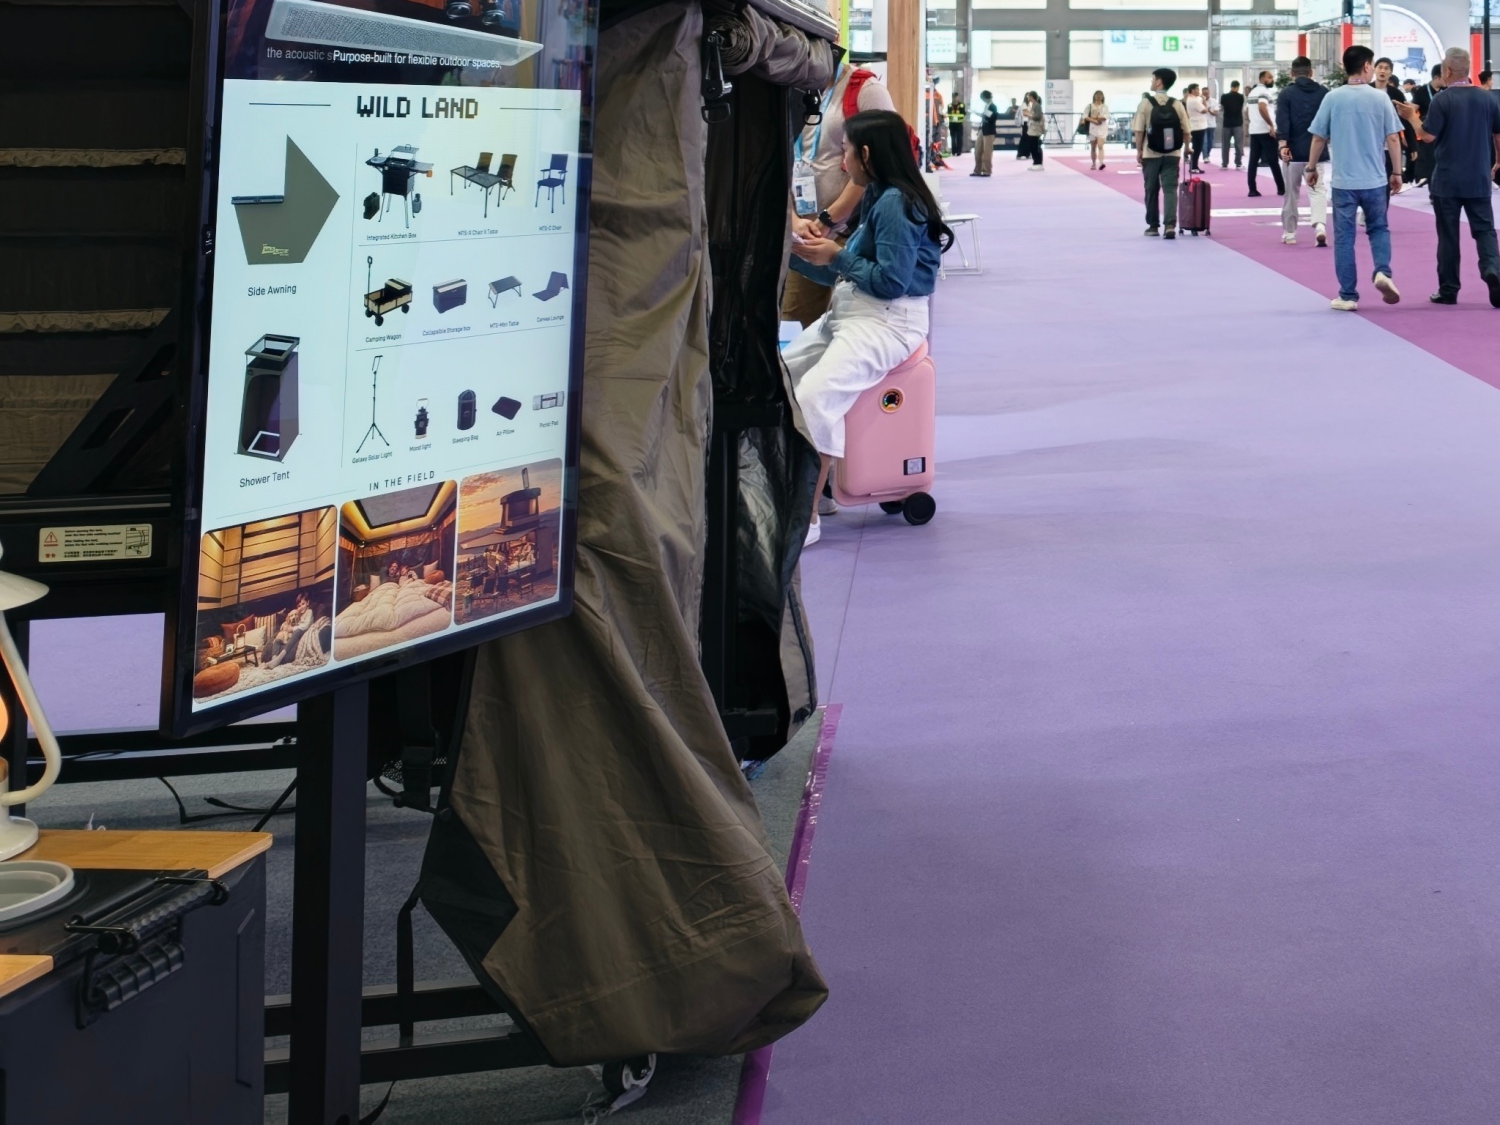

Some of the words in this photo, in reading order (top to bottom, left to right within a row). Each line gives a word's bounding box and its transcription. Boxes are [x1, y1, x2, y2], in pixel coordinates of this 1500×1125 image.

[266, 46, 282, 59] the
[285, 49, 325, 61] acoustic
[333, 49, 392, 66] Purpose-built
[394, 52, 406, 64] for
[408, 53, 438, 66] flexible
[439, 55, 470, 67] outdoor
[357, 95, 411, 118] WILD
[421, 96, 479, 119] LAND
[247, 286, 266, 296] Side
[267, 284, 297, 295] Awning
[365, 335, 386, 344] Camping
[386, 333, 402, 342] Wagon
[368, 453, 380, 462] Solar
[380, 450, 393, 460] Light
[239, 475, 270, 488] Shower
[272, 470, 290, 482] Tent
[368, 481, 379, 491] IN
[385, 477, 402, 488] THE
[407, 470, 435, 484] FIELD
